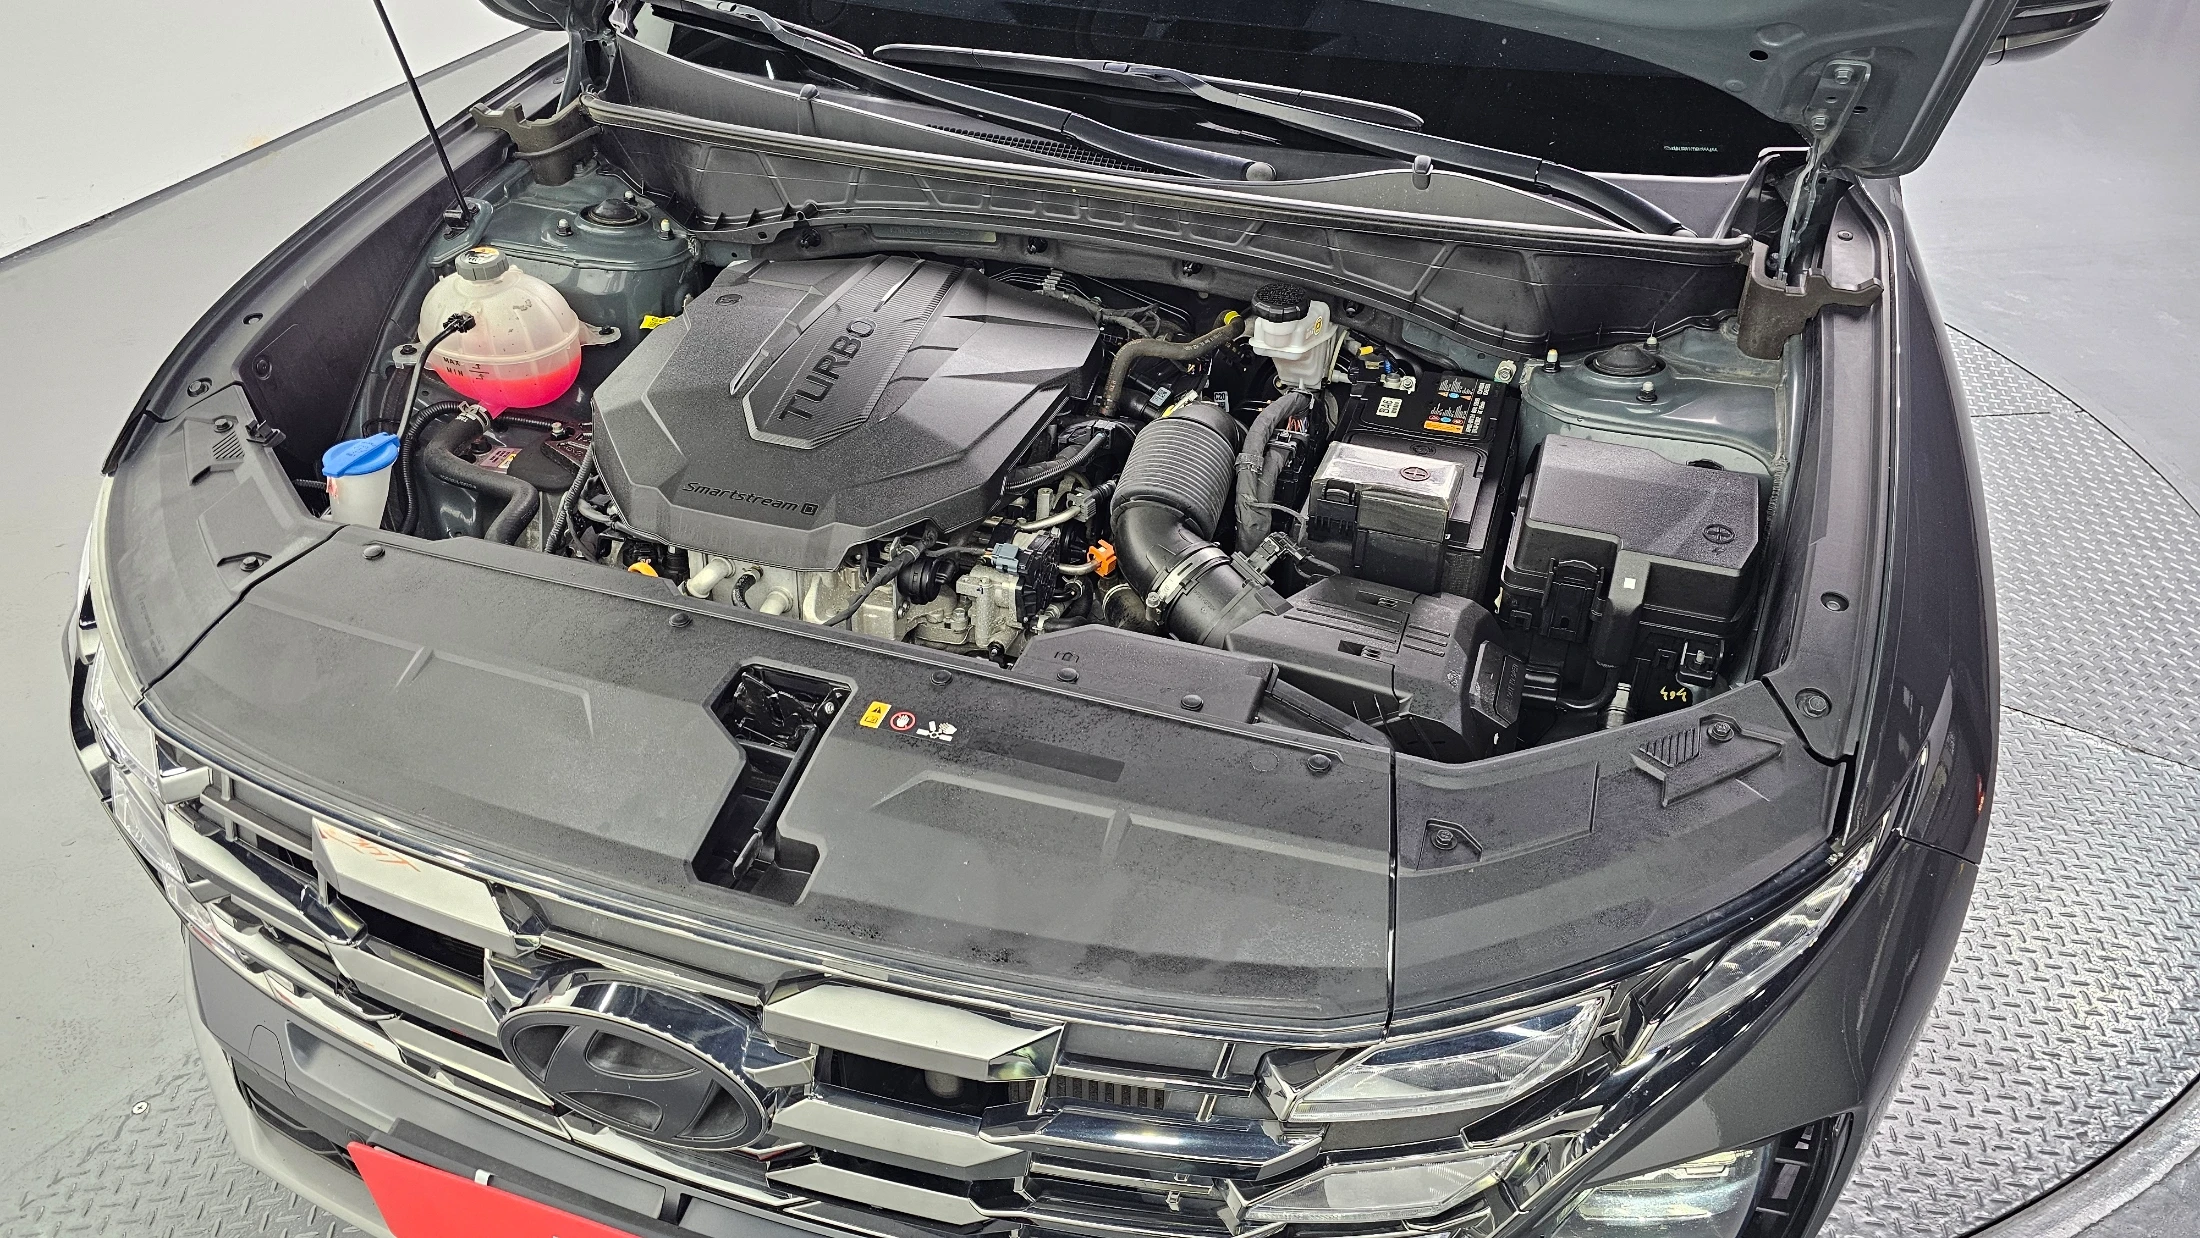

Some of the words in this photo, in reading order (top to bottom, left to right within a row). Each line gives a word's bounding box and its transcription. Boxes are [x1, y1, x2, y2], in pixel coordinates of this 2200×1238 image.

[443, 357, 461, 366] MAX
[777, 317, 877, 421] TURBO
[446, 367, 464, 376] MIN
[683, 481, 799, 511] Smartstream
